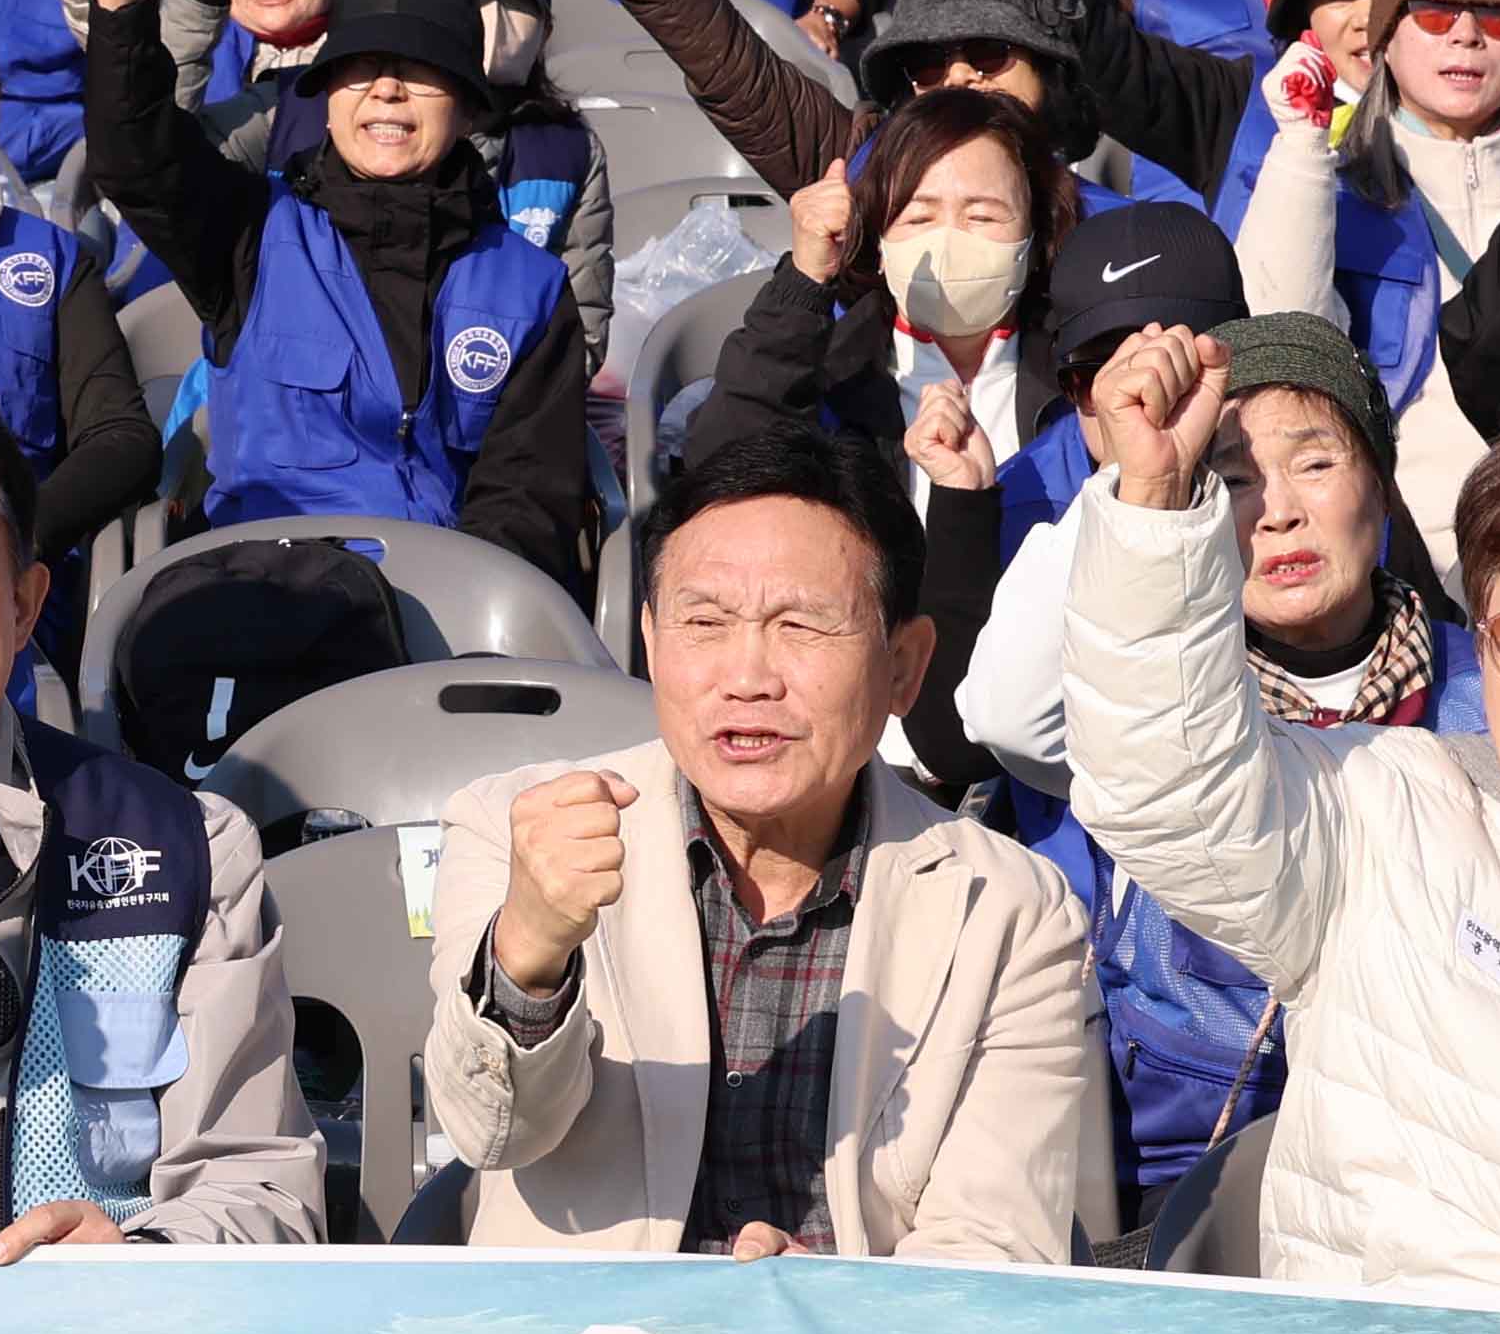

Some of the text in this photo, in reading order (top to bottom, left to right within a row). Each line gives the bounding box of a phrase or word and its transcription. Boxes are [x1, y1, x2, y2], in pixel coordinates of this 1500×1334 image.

[9, 270, 46, 286] KFF
[459, 347, 500, 372] KFF
[68, 850, 163, 892] KFF
